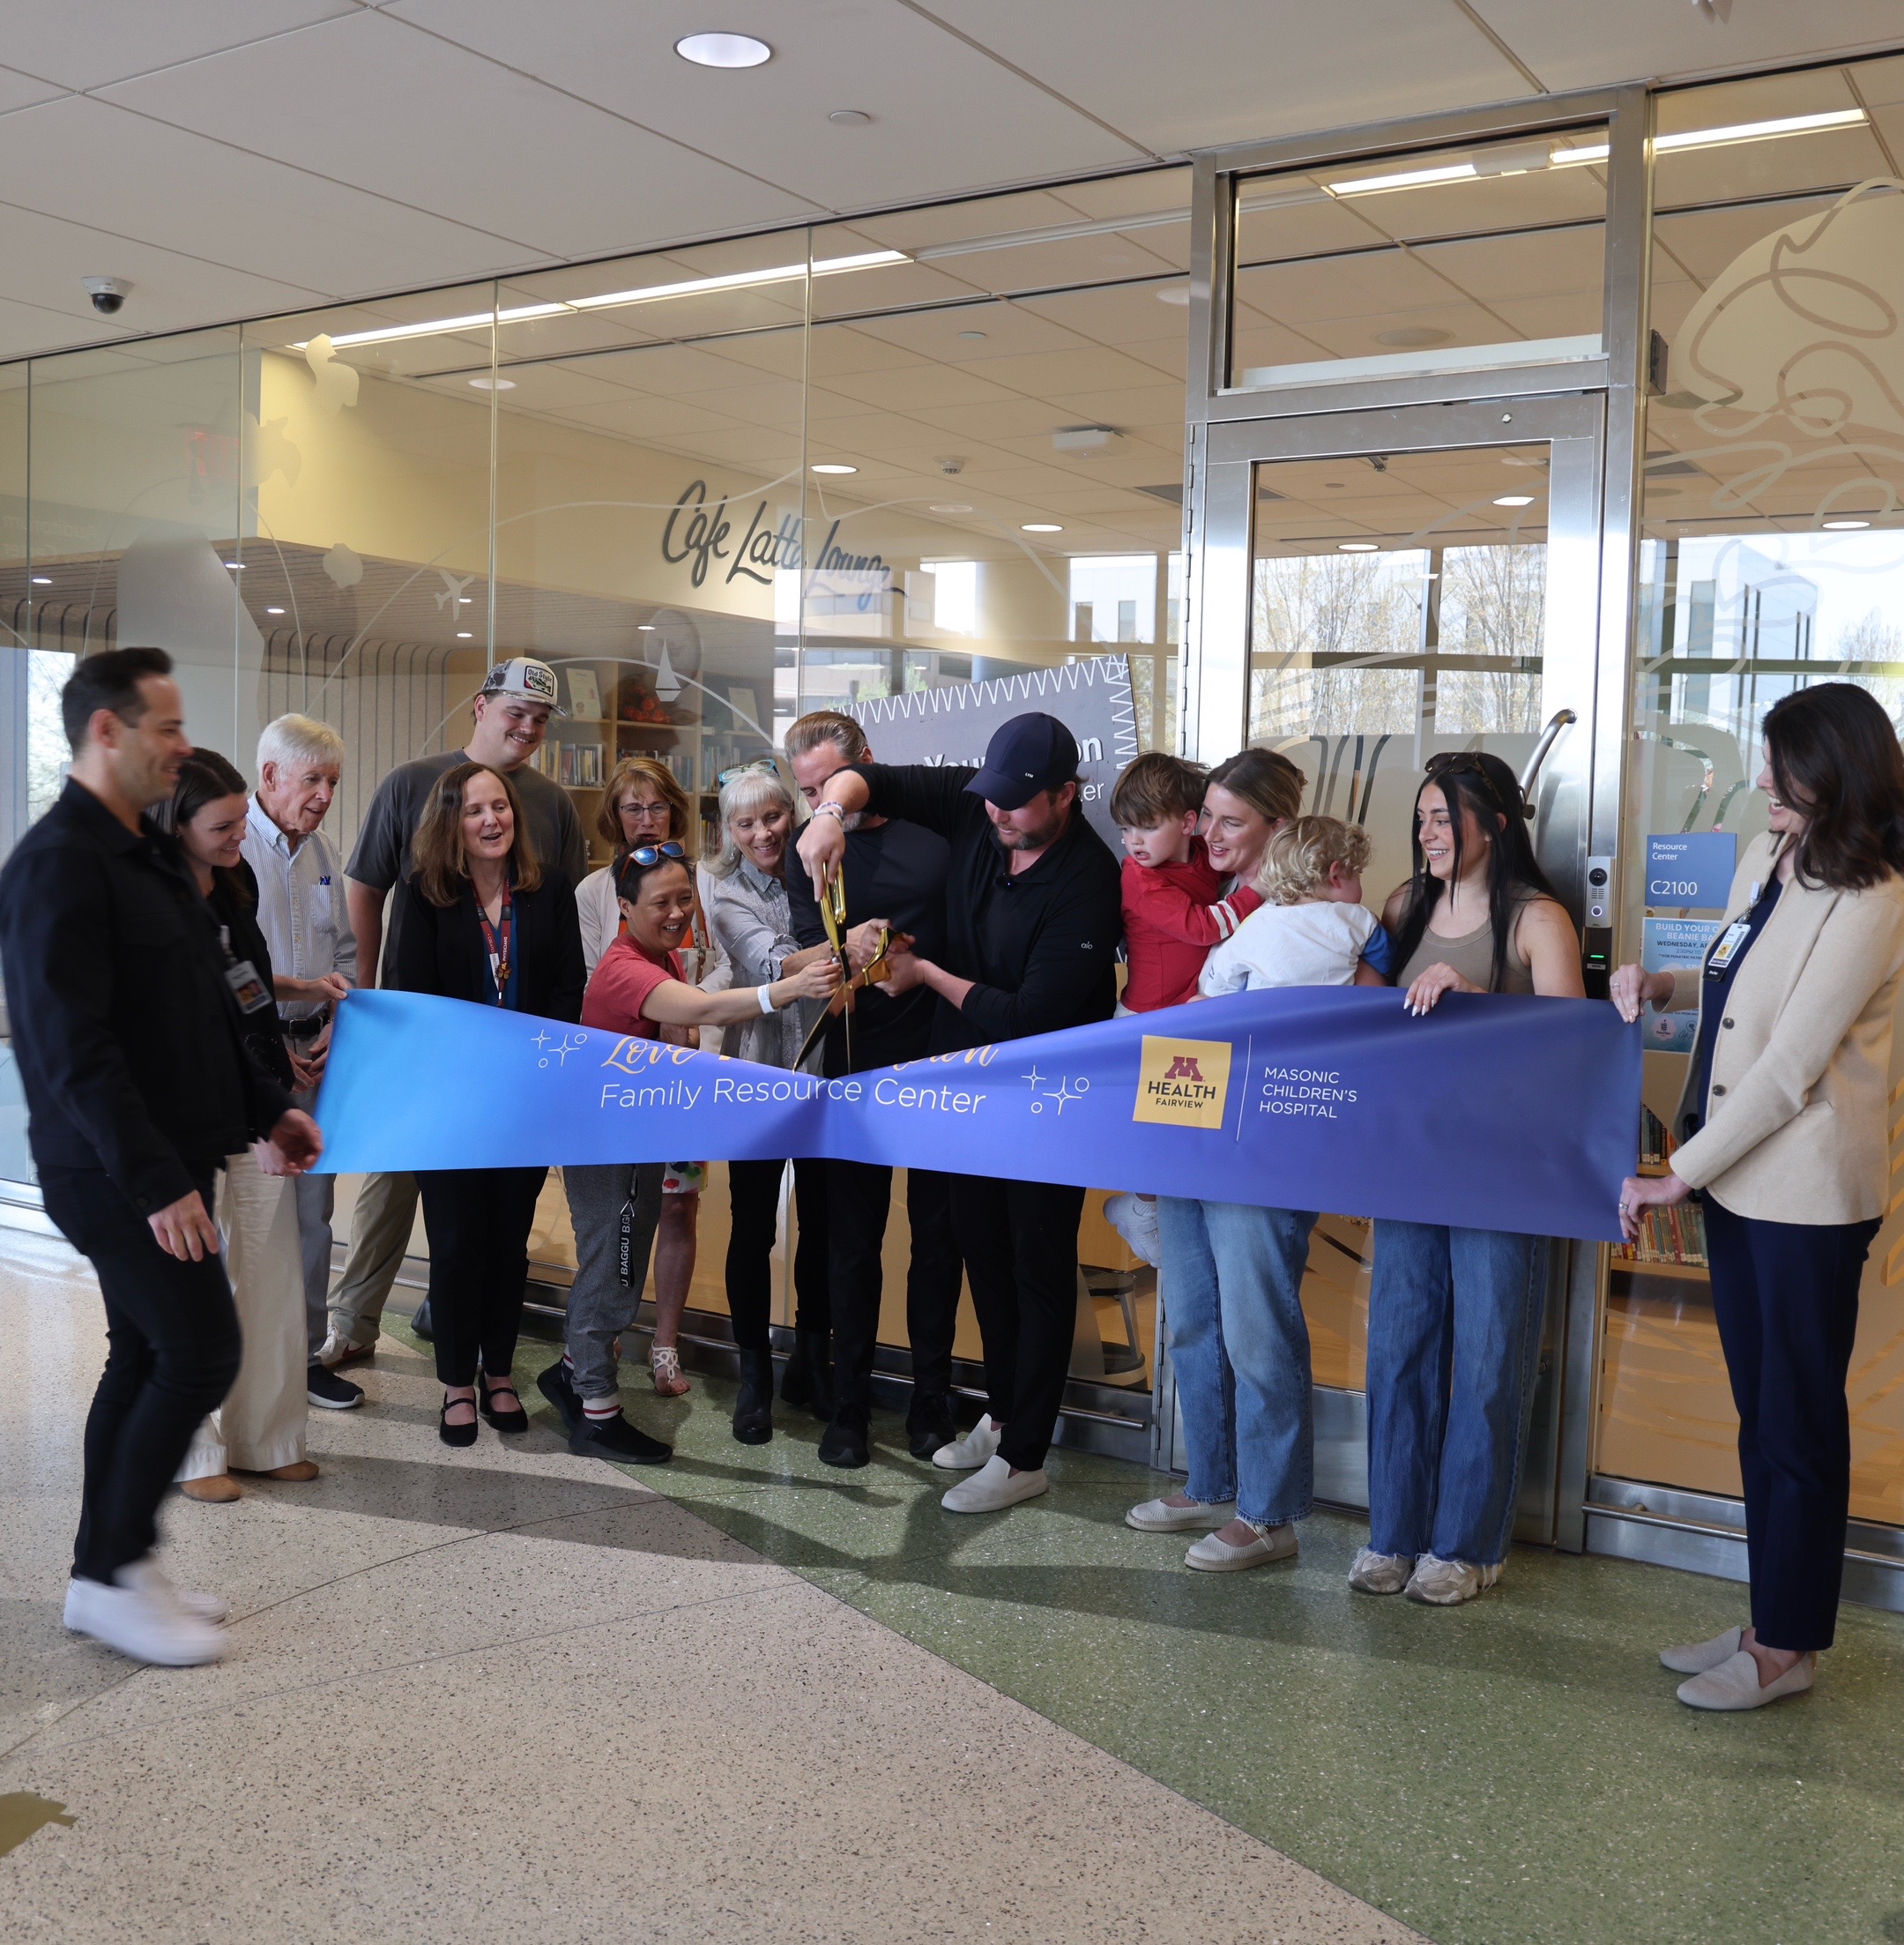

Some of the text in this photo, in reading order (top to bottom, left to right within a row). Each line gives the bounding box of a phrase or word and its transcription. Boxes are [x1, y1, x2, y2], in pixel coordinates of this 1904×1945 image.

[663, 480, 909, 611] Cafe Latte Lounge
[528, 668, 553, 682] Old Style
[1653, 842, 1688, 851] Resource
[1652, 852, 1678, 861] Center
[1650, 880, 1698, 896] C2100
[1655, 922, 1682, 931] BUILD
[1656, 940, 1699, 949] WEDNESDAY,
[1667, 932, 1699, 941] BEANIE
[1081, 941, 1093, 950] alo
[600, 1036, 702, 1075] Love
[1264, 1067, 1340, 1084] MASONIC
[600, 1077, 986, 1114] Family Resource Center
[1148, 1081, 1216, 1100] HEALTH
[1261, 1084, 1358, 1103] CHILDREN'S
[1155, 1097, 1204, 1109] FAIRVIEW
[1259, 1100, 1338, 1119] HOSPITAL
[621, 1237, 629, 1275] BAGGU
